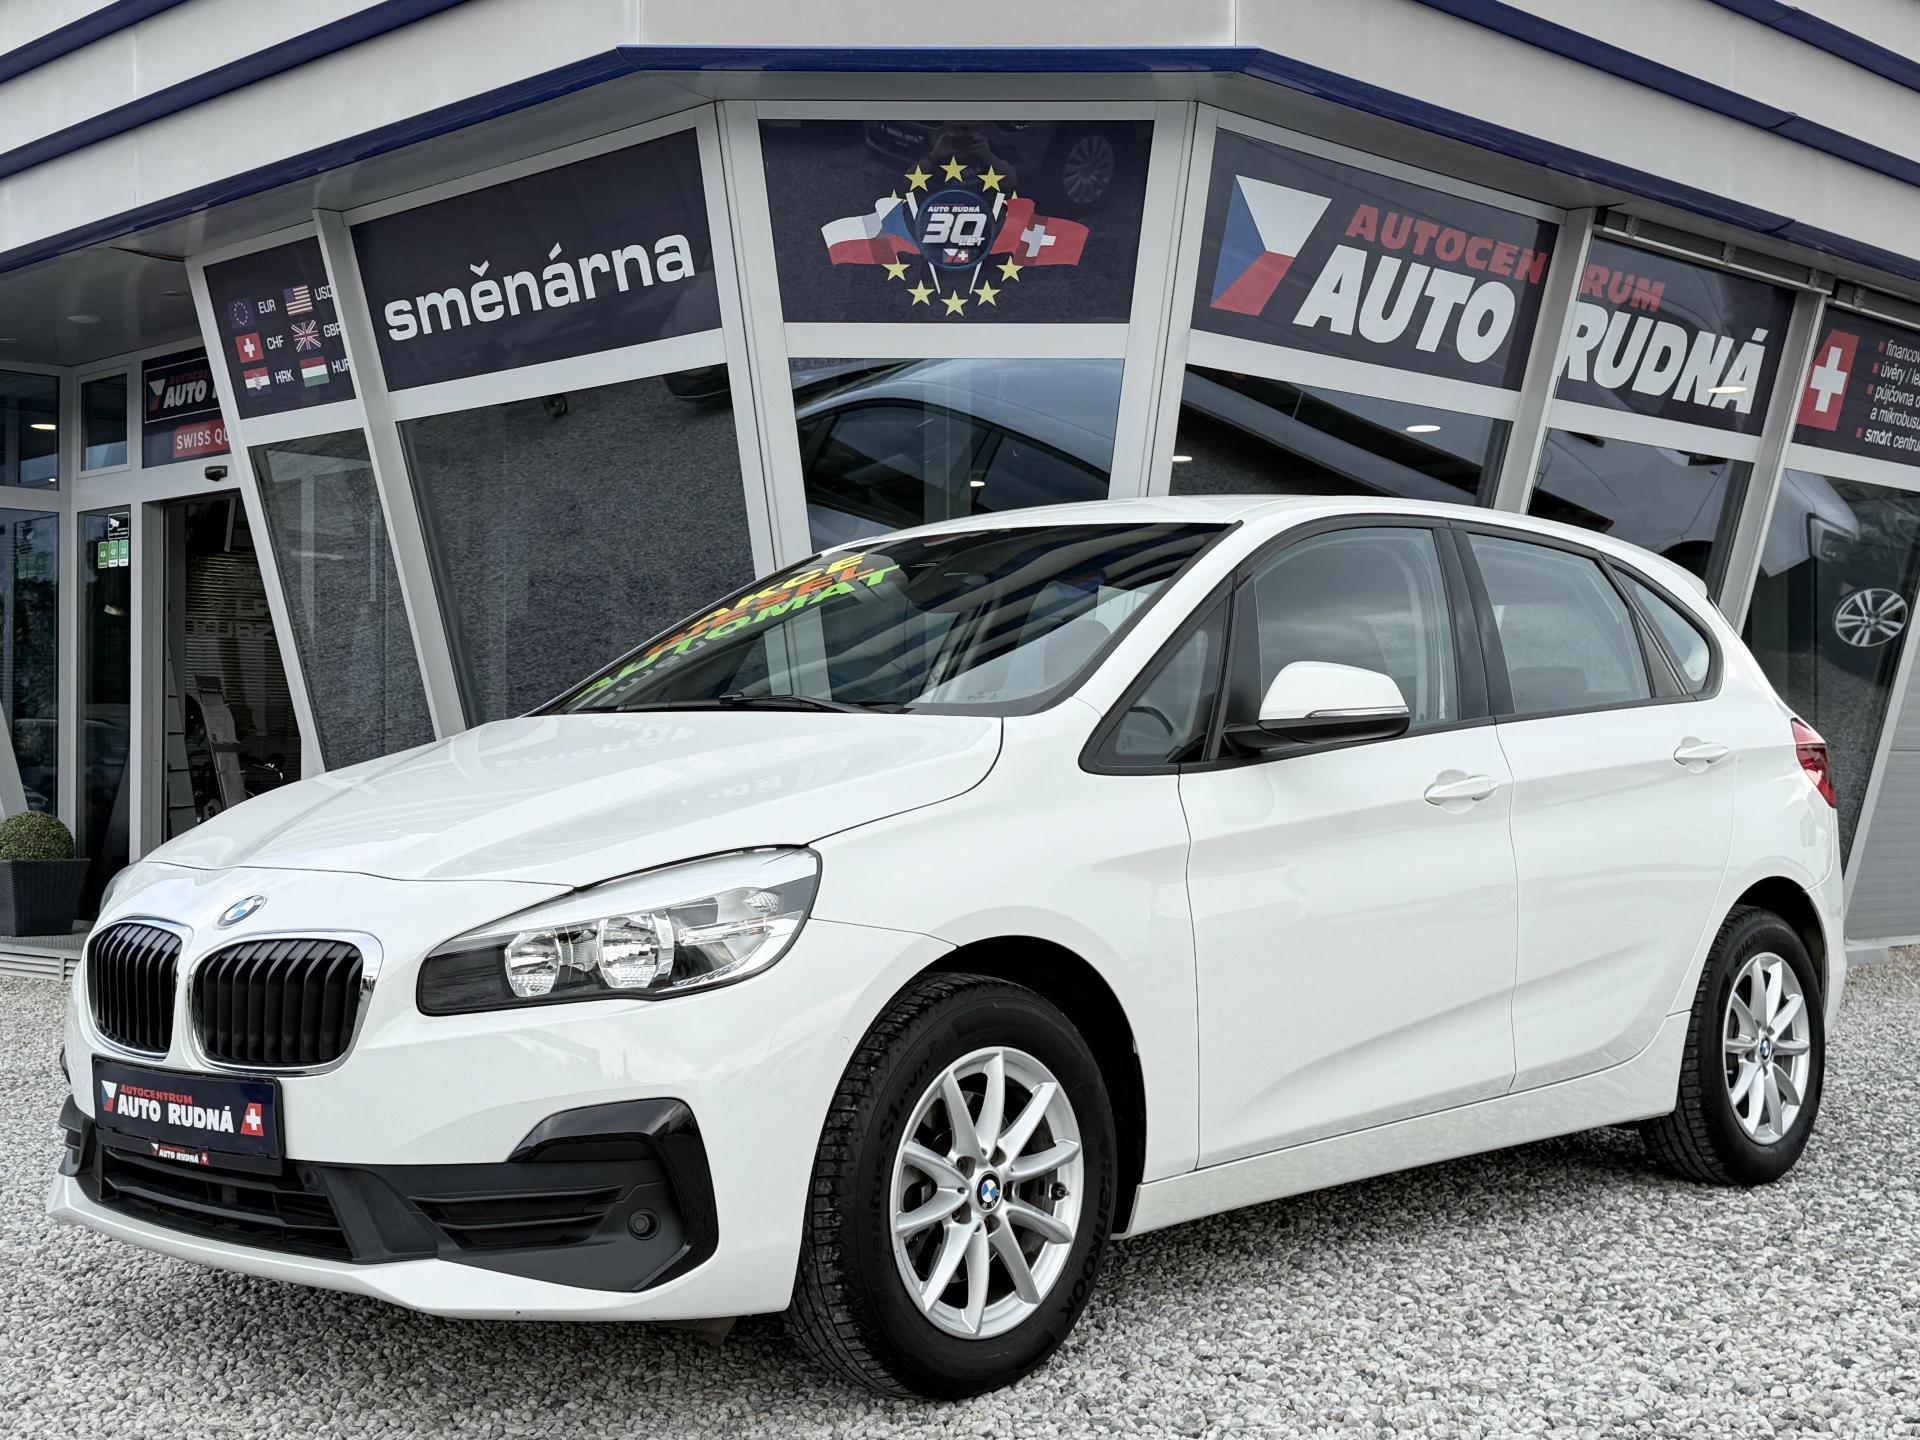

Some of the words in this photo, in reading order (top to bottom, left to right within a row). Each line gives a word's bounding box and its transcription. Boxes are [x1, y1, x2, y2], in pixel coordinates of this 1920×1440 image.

[927, 205, 950, 213] AUTO
[951, 204, 980, 213] RUDNÁ
[922, 212, 988, 244] 30
[1344, 203, 1549, 285] AUTOCEN
[1579, 263, 1666, 313] RUM
[383, 233, 696, 342] směnárna
[257, 299, 277, 314] EUR
[1292, 244, 1517, 364] AUTO
[1559, 300, 1769, 415] RUDNÁ
[266, 335, 284, 350] CHF
[274, 369, 294, 384] HRK
[163, 379, 207, 409] AUTO
[176, 429, 211, 450] SWISS
[119, 1084, 193, 1105] AUTOCENTRUM
[117, 1094, 162, 1122] AUTO
[168, 1102, 235, 1133] RUDNÁ
